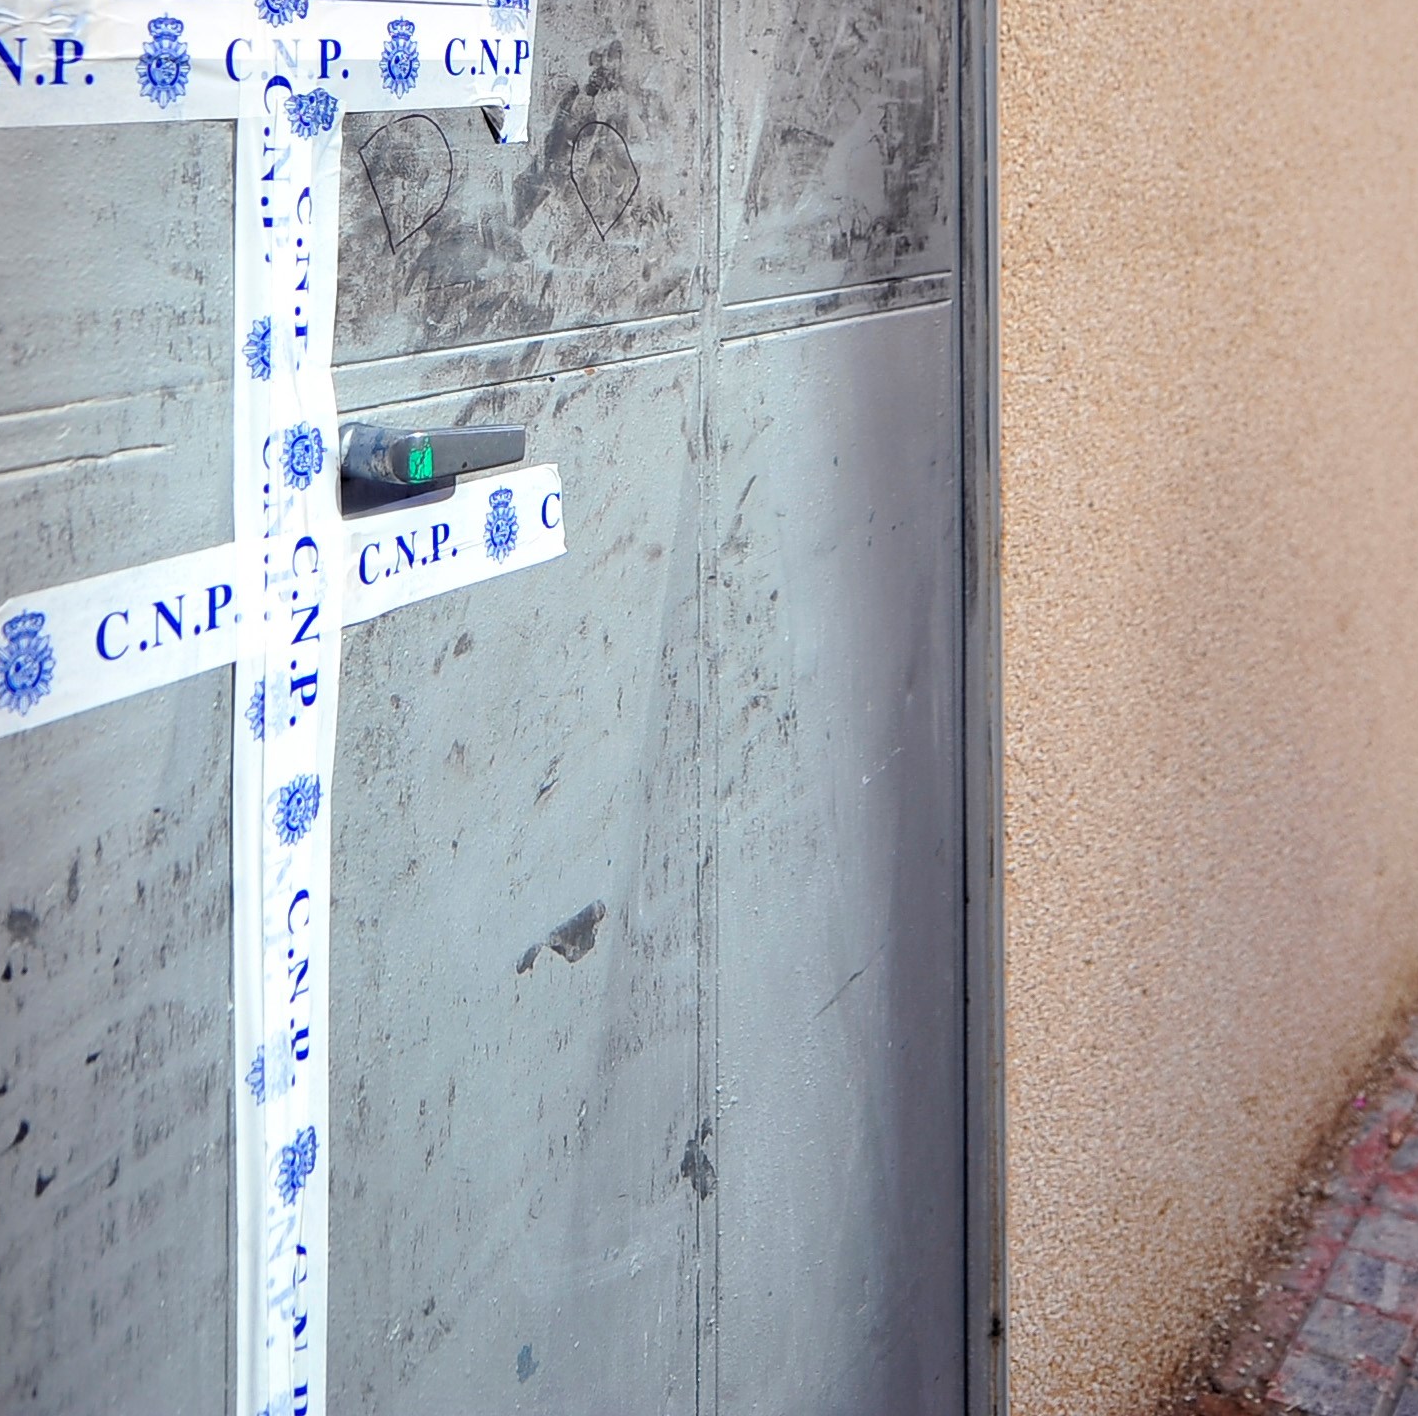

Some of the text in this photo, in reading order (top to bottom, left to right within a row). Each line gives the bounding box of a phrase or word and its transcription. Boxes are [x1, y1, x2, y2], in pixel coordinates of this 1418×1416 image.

[224, 37, 350, 83] C.N.P.
[357, 521, 459, 585] C.N.P.
[289, 536, 322, 728] C.N.P.
